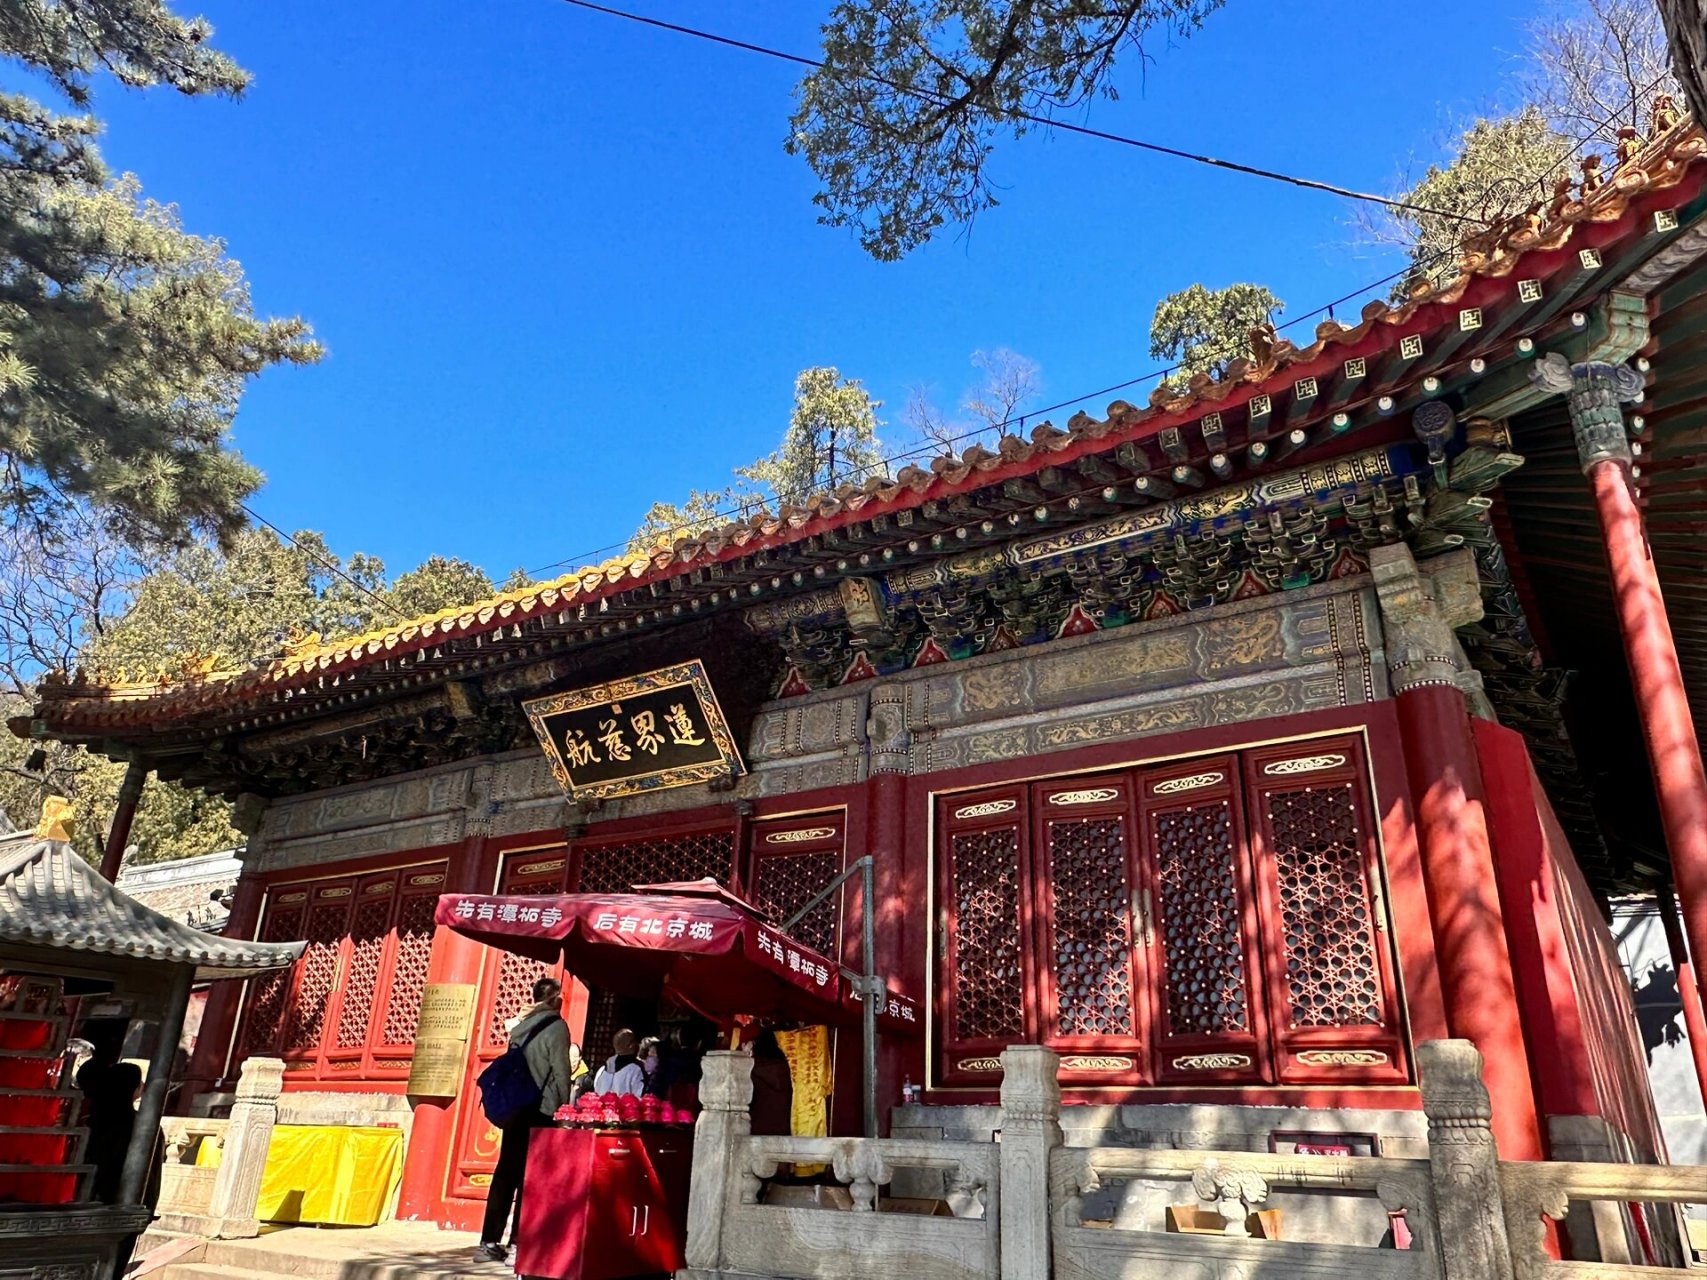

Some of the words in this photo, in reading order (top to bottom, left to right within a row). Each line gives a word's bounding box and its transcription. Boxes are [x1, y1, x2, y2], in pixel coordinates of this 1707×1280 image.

[593, 913, 714, 940] 后有北京城
